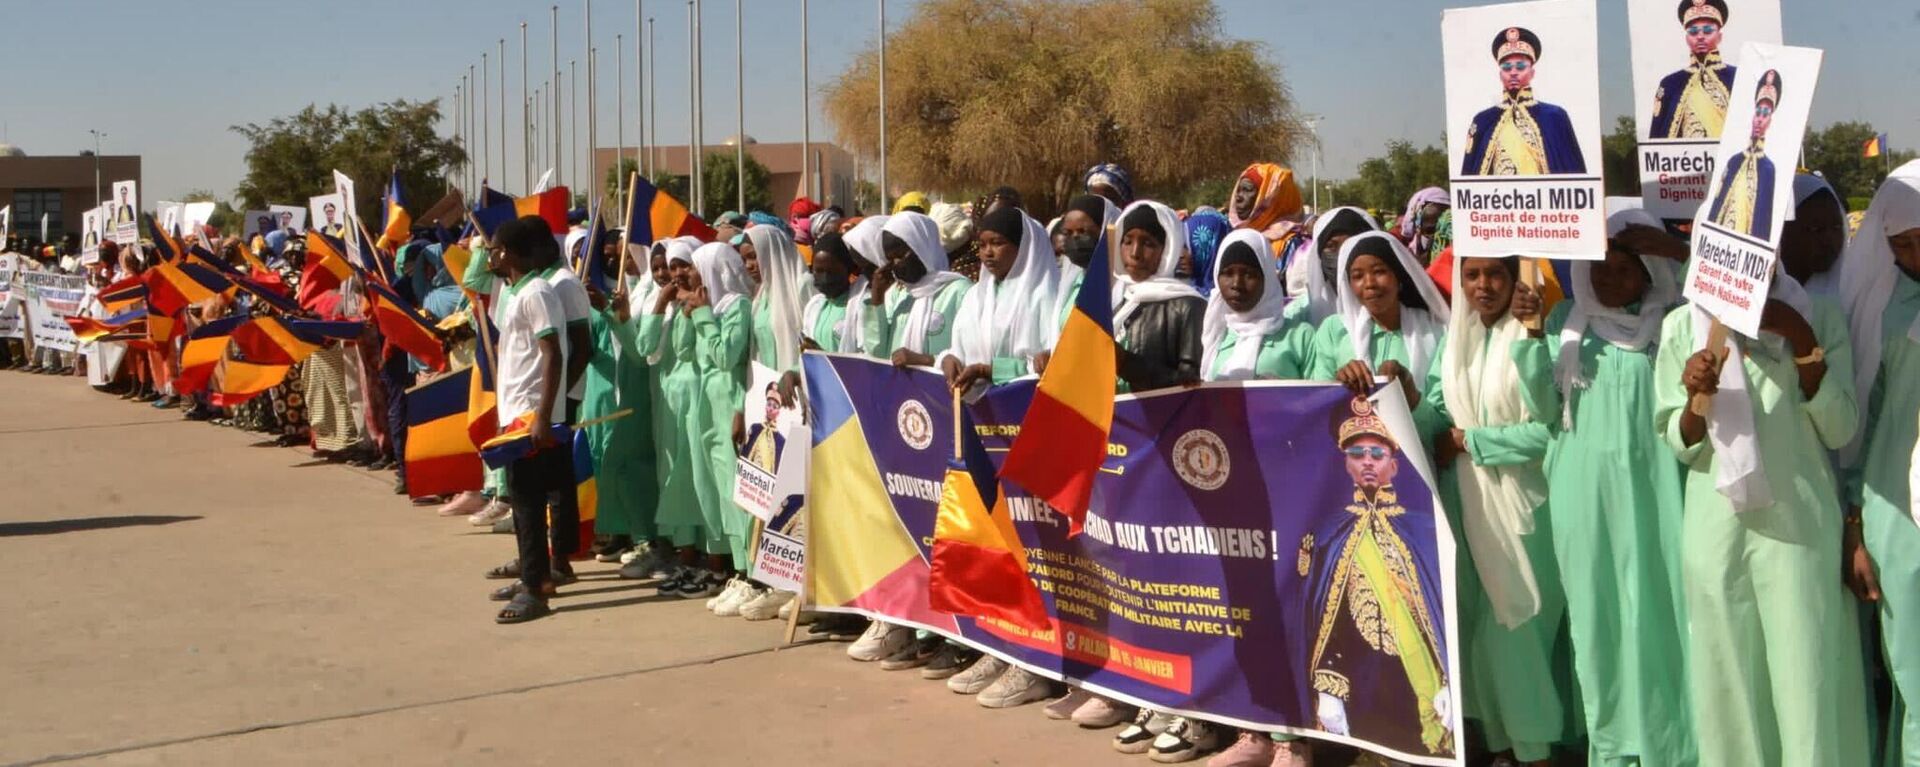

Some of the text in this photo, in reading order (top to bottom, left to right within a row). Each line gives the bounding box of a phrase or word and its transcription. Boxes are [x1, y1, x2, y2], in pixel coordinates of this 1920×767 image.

[1659, 174, 1706, 185] Garant
[1457, 188, 1595, 210] Maréchal MIDI
[1660, 188, 1705, 202] Dignité
[1470, 211, 1580, 224] Garant de notre
[1470, 225, 1580, 240] Dignité Nationale
[1722, 271, 1733, 285] de
[736, 462, 771, 493] Maréchal
[886, 472, 945, 504] SOUVERA
[1084, 510, 1114, 546] CHAD
[1114, 521, 1150, 554] AUX
[1151, 526, 1266, 560] TCHADIENS
[1271, 530, 1279, 561] !
[760, 561, 790, 579] Dignité
[763, 552, 795, 570] Garant
[1101, 567, 1118, 584] PAR
[1118, 575, 1131, 589] LA
[1130, 578, 1220, 601] PLATEFORME
[1040, 580, 1056, 593] DE
[1124, 608, 1182, 631] MILITAIRE
[1184, 619, 1224, 635] AVEC
[1225, 623, 1244, 638] LA
[1145, 598, 1228, 619] L'INITIATIVE
[1231, 607, 1251, 621] DE
[1132, 655, 1175, 680] JANVIER
